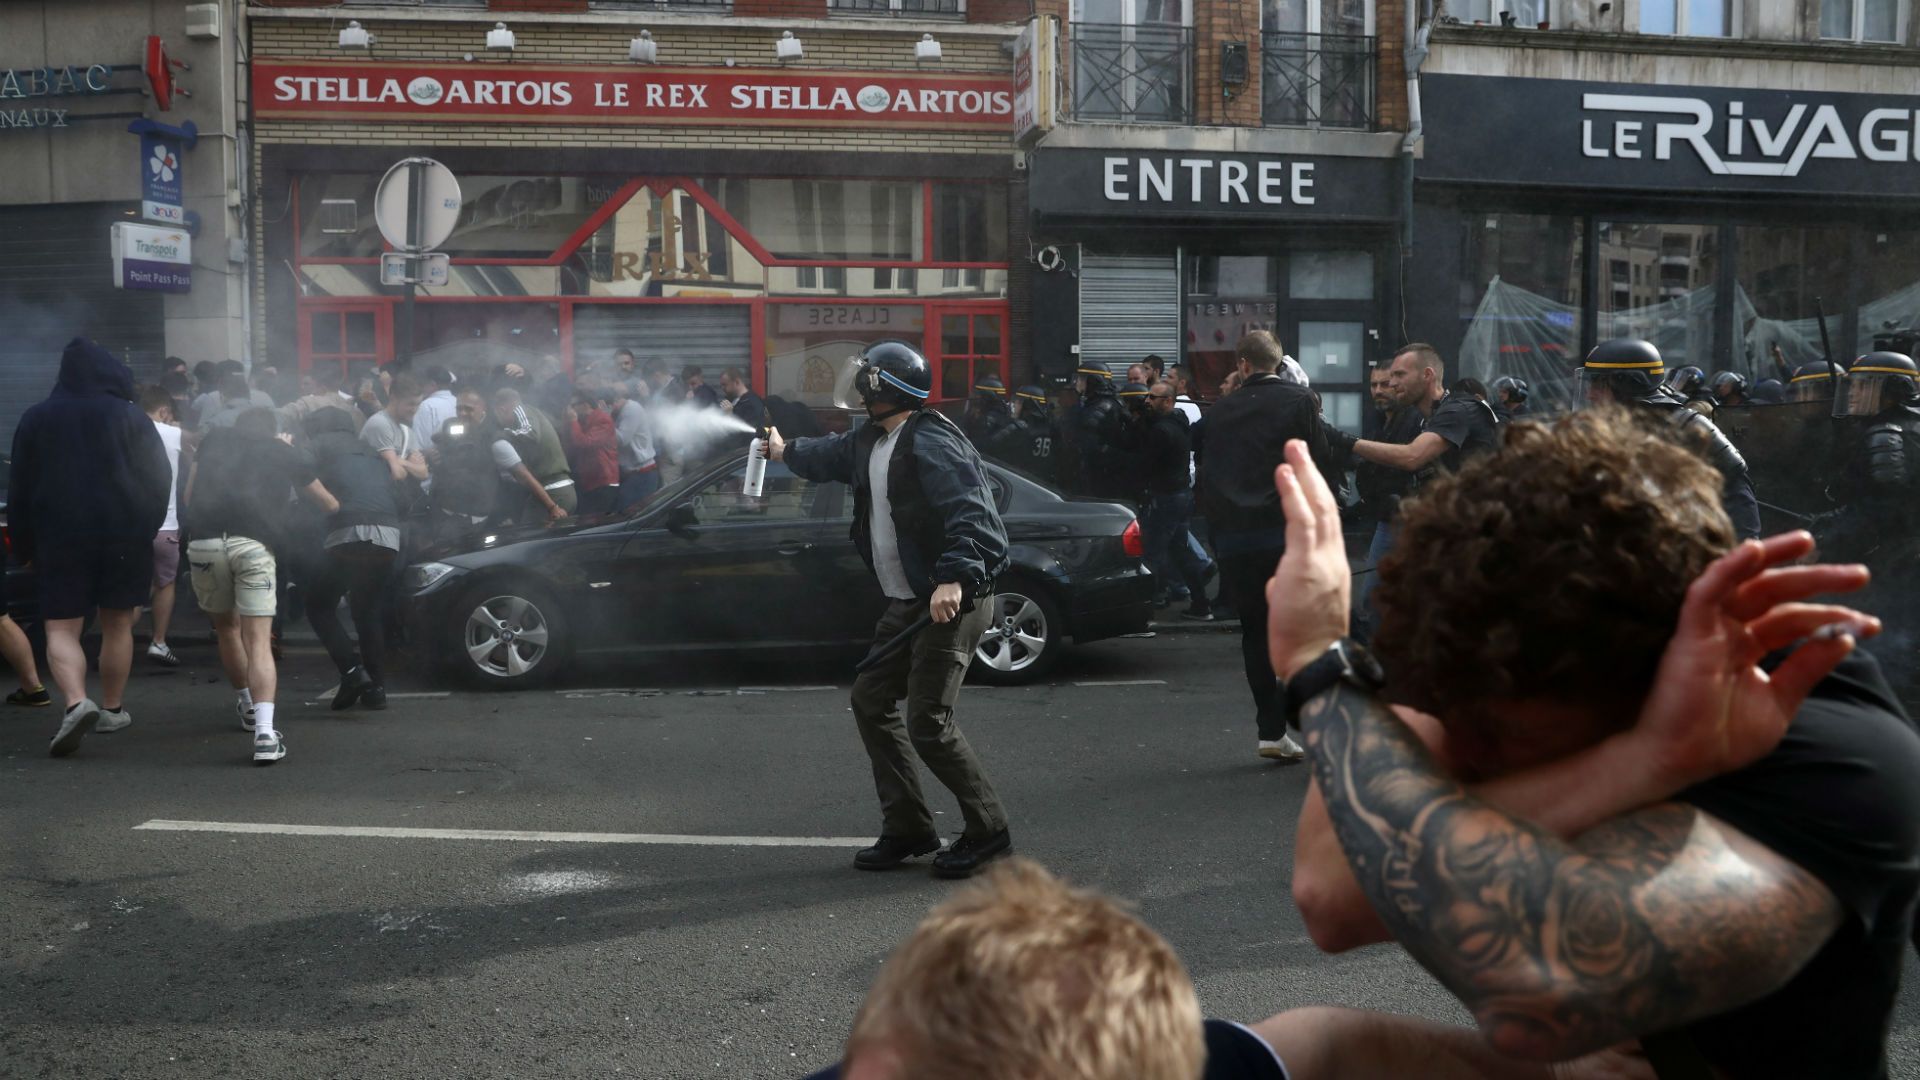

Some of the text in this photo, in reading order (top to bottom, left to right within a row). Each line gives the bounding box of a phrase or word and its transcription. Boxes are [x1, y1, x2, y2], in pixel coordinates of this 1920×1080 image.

[274, 75, 1011, 114] STELLA ARTOIS LE REX STELLA ARTOIS
[1582, 119, 1643, 159] LE
[1103, 156, 1316, 205] ENTREE
[136, 239, 178, 256] Transpole
[130, 270, 190, 285] Point Pass Pass
[612, 252, 713, 281] REX
